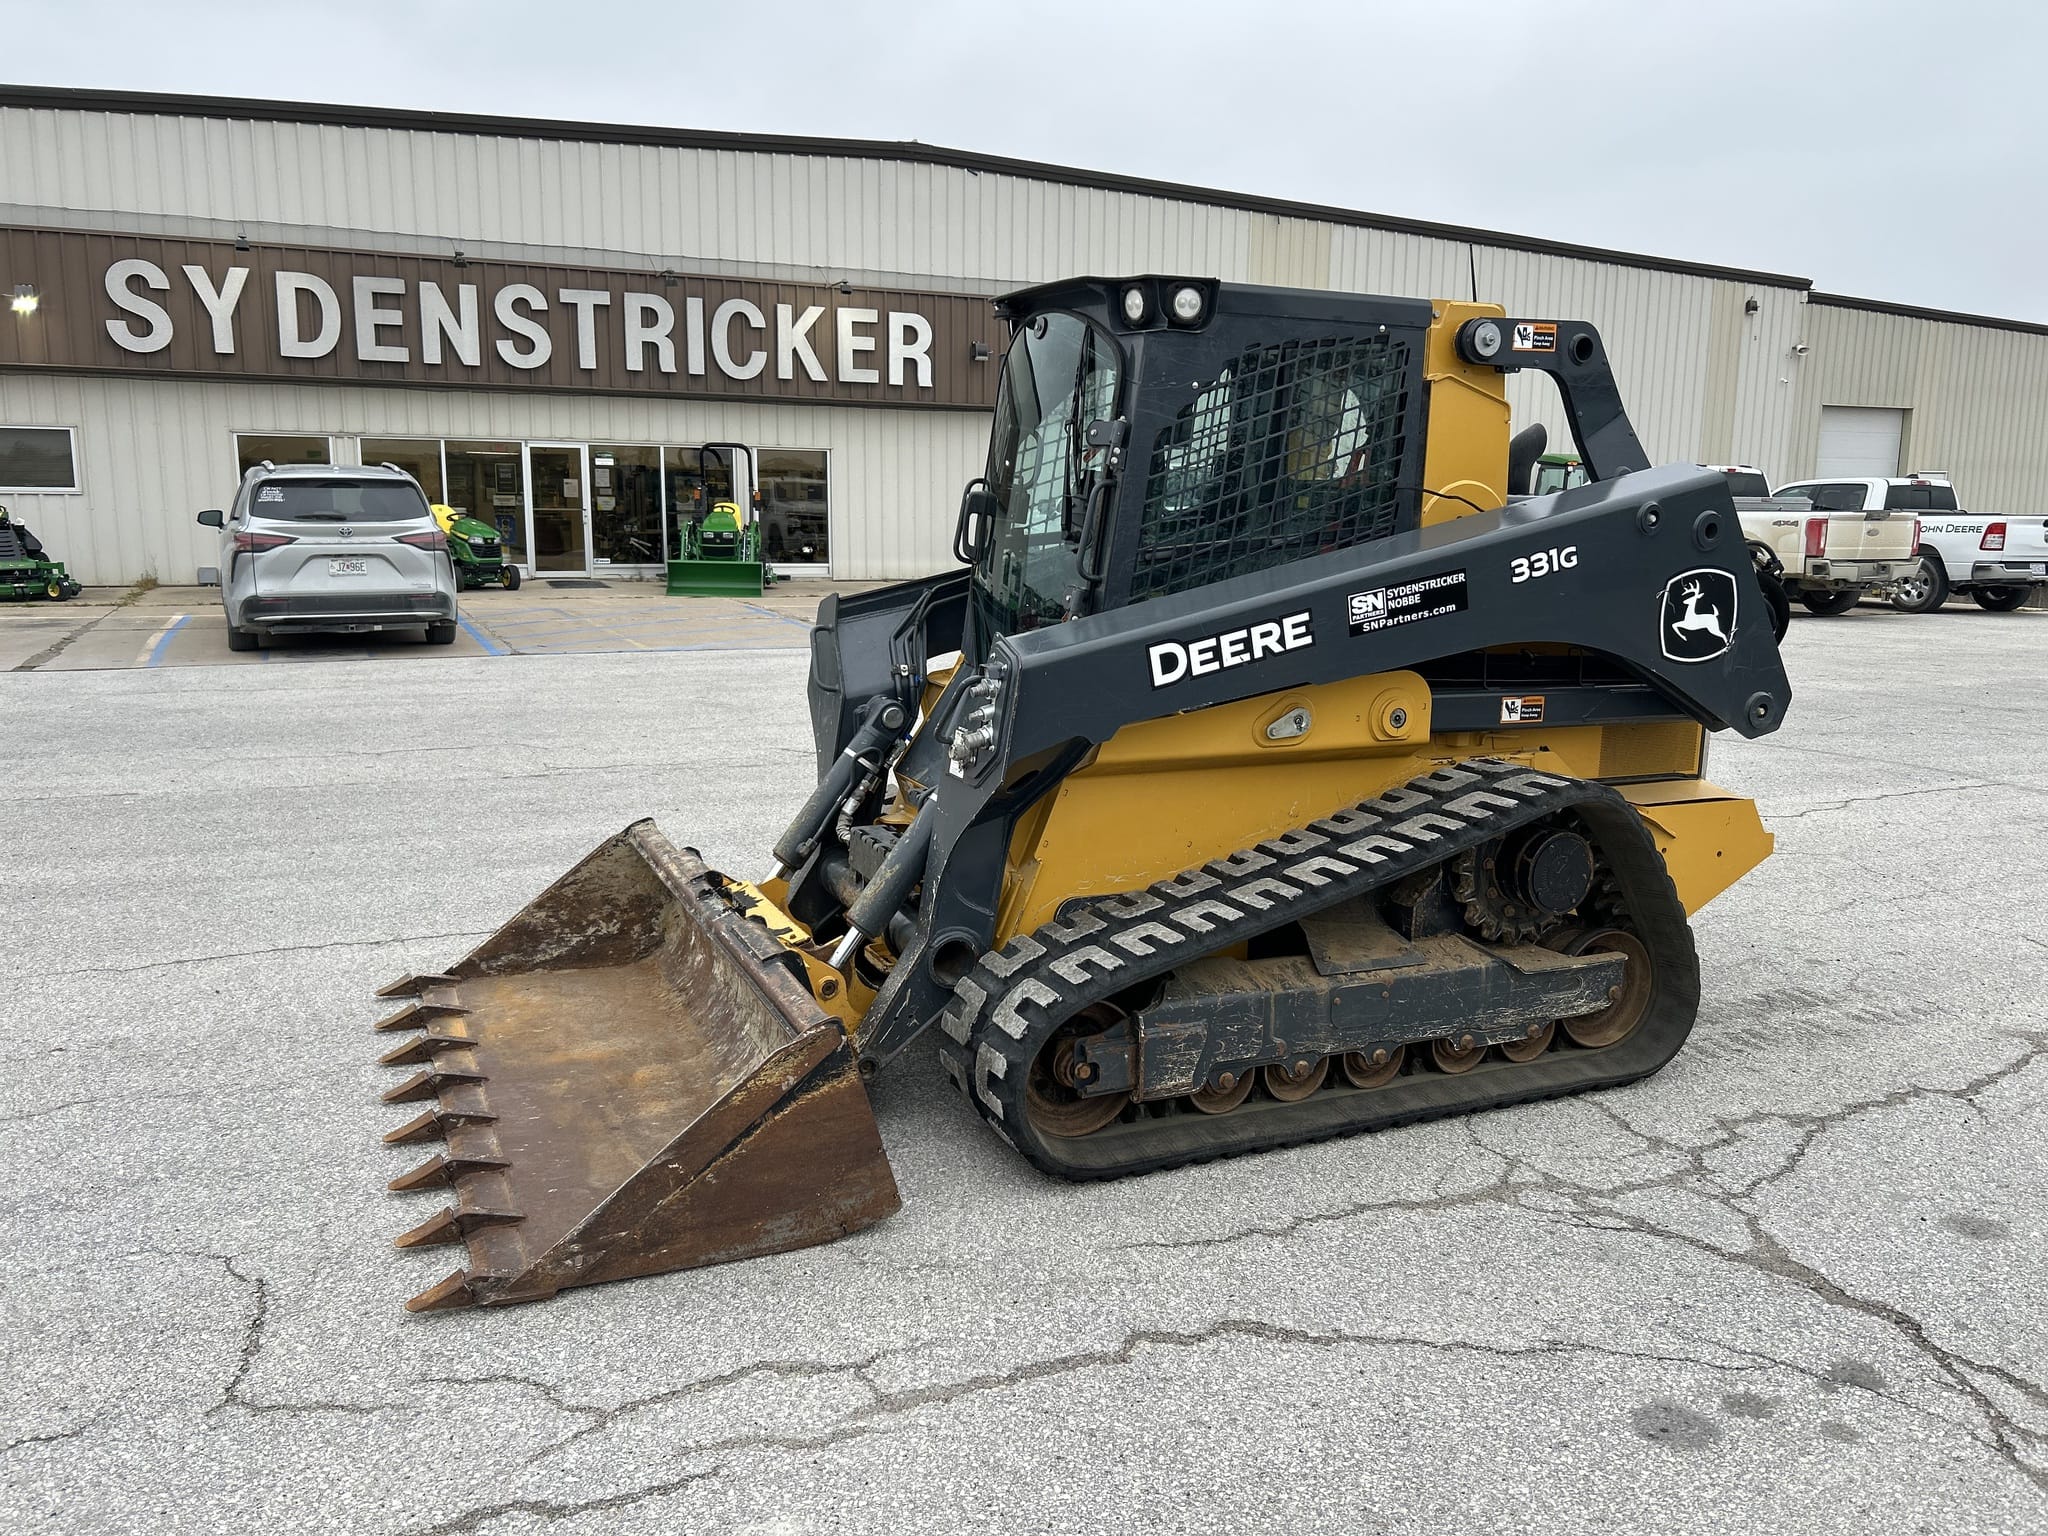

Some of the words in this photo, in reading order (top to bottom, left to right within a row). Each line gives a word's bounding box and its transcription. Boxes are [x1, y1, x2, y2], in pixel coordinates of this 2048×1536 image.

[104, 258, 934, 389] SYDENSTRICKER
[1919, 525, 1944, 533] OHN
[1946, 524, 1983, 534] DEERE
[1510, 546, 1578, 583] 331G
[1386, 573, 1466, 599] SYDENSTRICKER
[1351, 591, 1384, 614] SN
[1387, 593, 1421, 609] NOBBE
[1352, 609, 1384, 621] PARTNERS
[1362, 603, 1456, 632] SNPartners.com
[1149, 612, 1313, 687] DEERE
